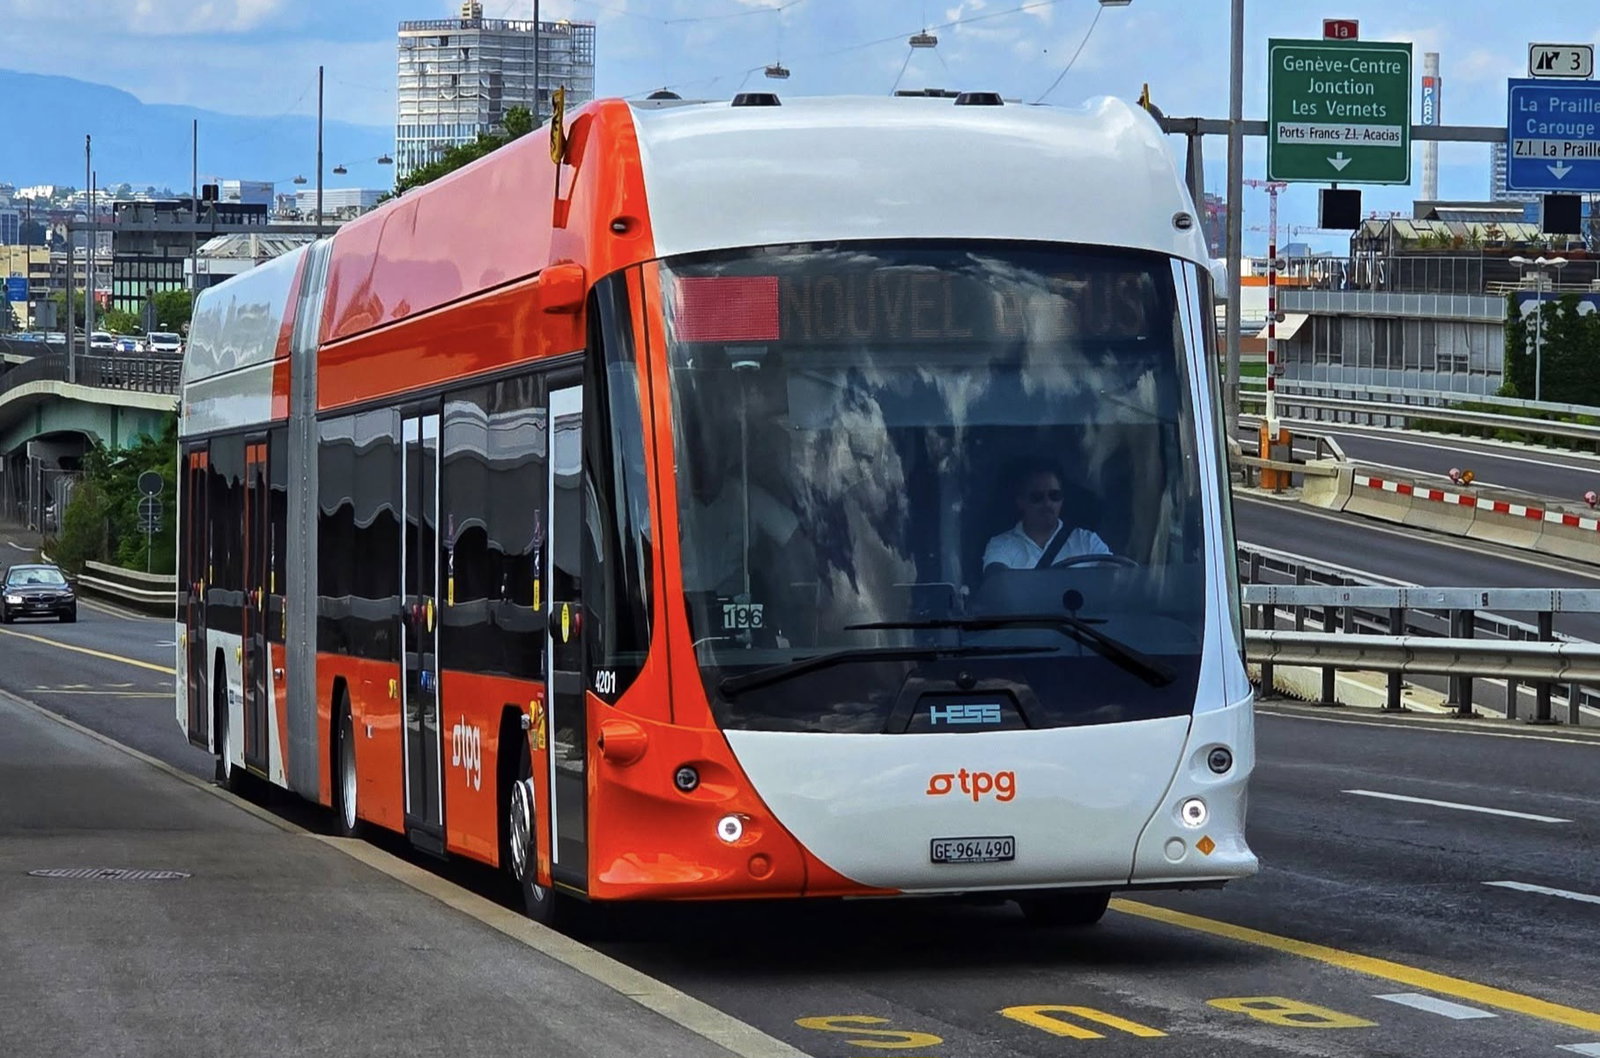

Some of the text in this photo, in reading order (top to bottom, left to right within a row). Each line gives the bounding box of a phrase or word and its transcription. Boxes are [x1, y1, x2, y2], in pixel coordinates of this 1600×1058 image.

[1334, 23, 1348, 37] 1a
[1283, 55, 1401, 74] Genève-Centre
[1570, 52, 1581, 70] 3
[1308, 78, 1374, 95] Jonction
[1292, 100, 1387, 117] Les Vernets
[1520, 96, 1538, 112] La
[1279, 126, 1305, 139] Ports
[1309, 127, 1340, 140] Francs
[1362, 129, 1400, 142] Acacias
[1526, 119, 1595, 138] Carouge
[1515, 140, 1536, 156] Z.I.
[1543, 141, 1557, 157] La
[723, 604, 763, 628] 196
[595, 670, 616, 694] 4201
[930, 704, 1001, 725] HESS
